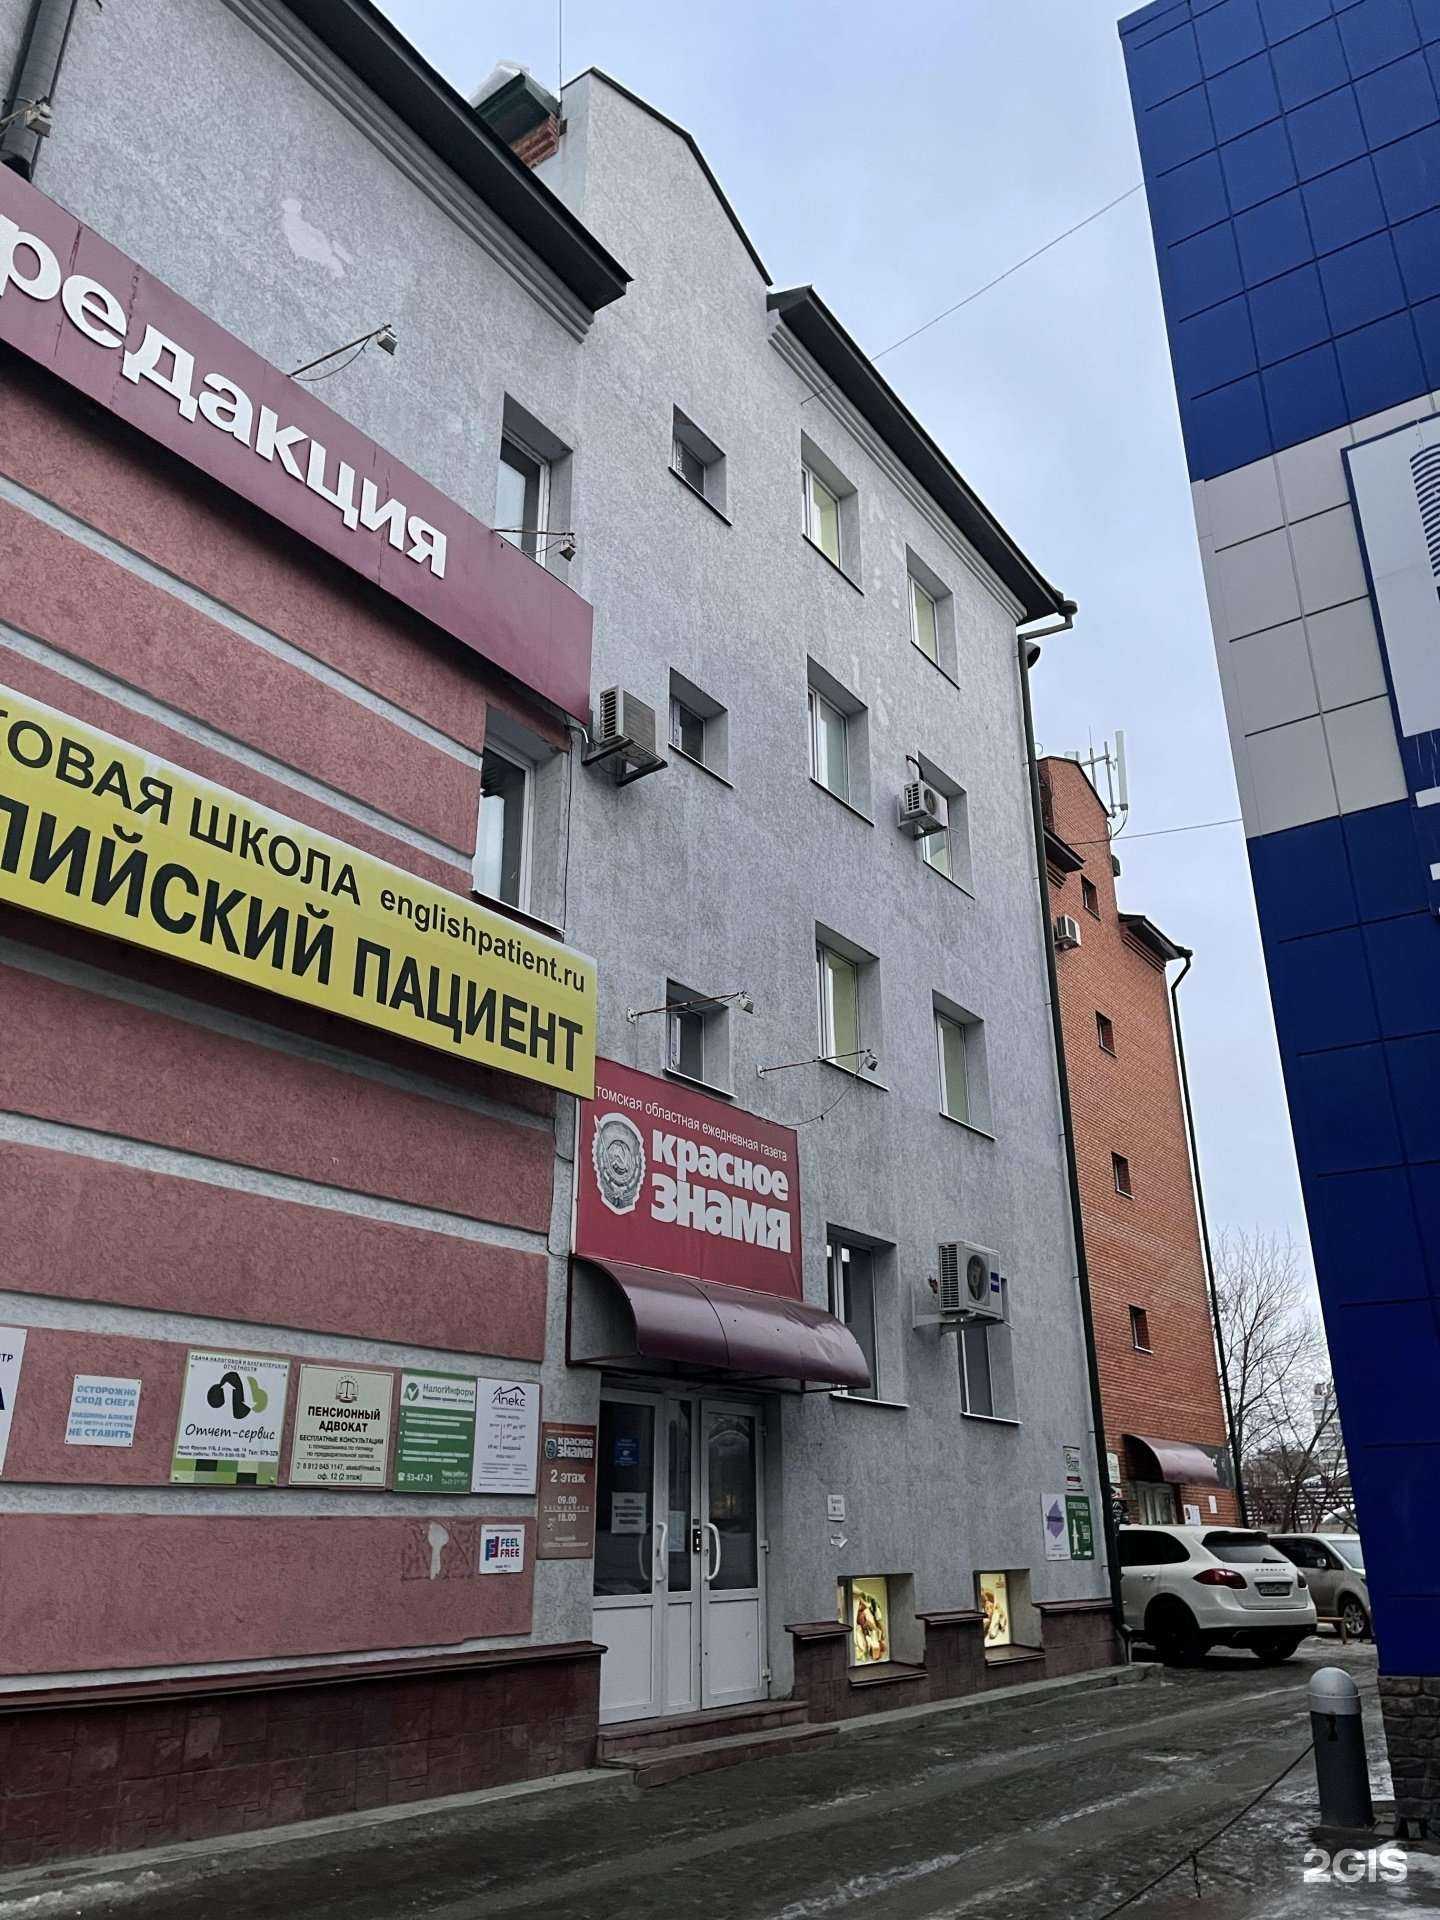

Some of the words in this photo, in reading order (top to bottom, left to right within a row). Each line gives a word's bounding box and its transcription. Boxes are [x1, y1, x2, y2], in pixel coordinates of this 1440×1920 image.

[0, 214, 446, 578] редакция
[189, 797, 361, 905] ШКОЛА
[381, 889, 585, 992] englishpatient.ru
[353, 937, 583, 1072] ПАЦИЕНТ
[596, 1085, 642, 1112] томская
[646, 1103, 699, 1131] областная
[702, 1124, 758, 1151] ежедневная
[760, 1143, 787, 1162] газета
[77, 1385, 136, 1396] ОСТОРОЖНО
[75, 1396, 102, 1407] СХОД
[105, 1397, 135, 1407] СНЕГА
[492, 1391, 526, 1407] Апекс
[308, 1406, 381, 1420] ПЕНСИОННЫЙ
[69, 1428, 81, 1437] НЕ
[84, 1428, 131, 1438] СТАВИТЬ
[185, 1424, 275, 1443] Отчет-сервис
[319, 1421, 368, 1432] АДВОКАТ
[550, 1469, 558, 1483] 2
[560, 1472, 586, 1483] этаж
[500, 1537, 520, 1547] FEEL
[500, 1548, 520, 1558] FREE
